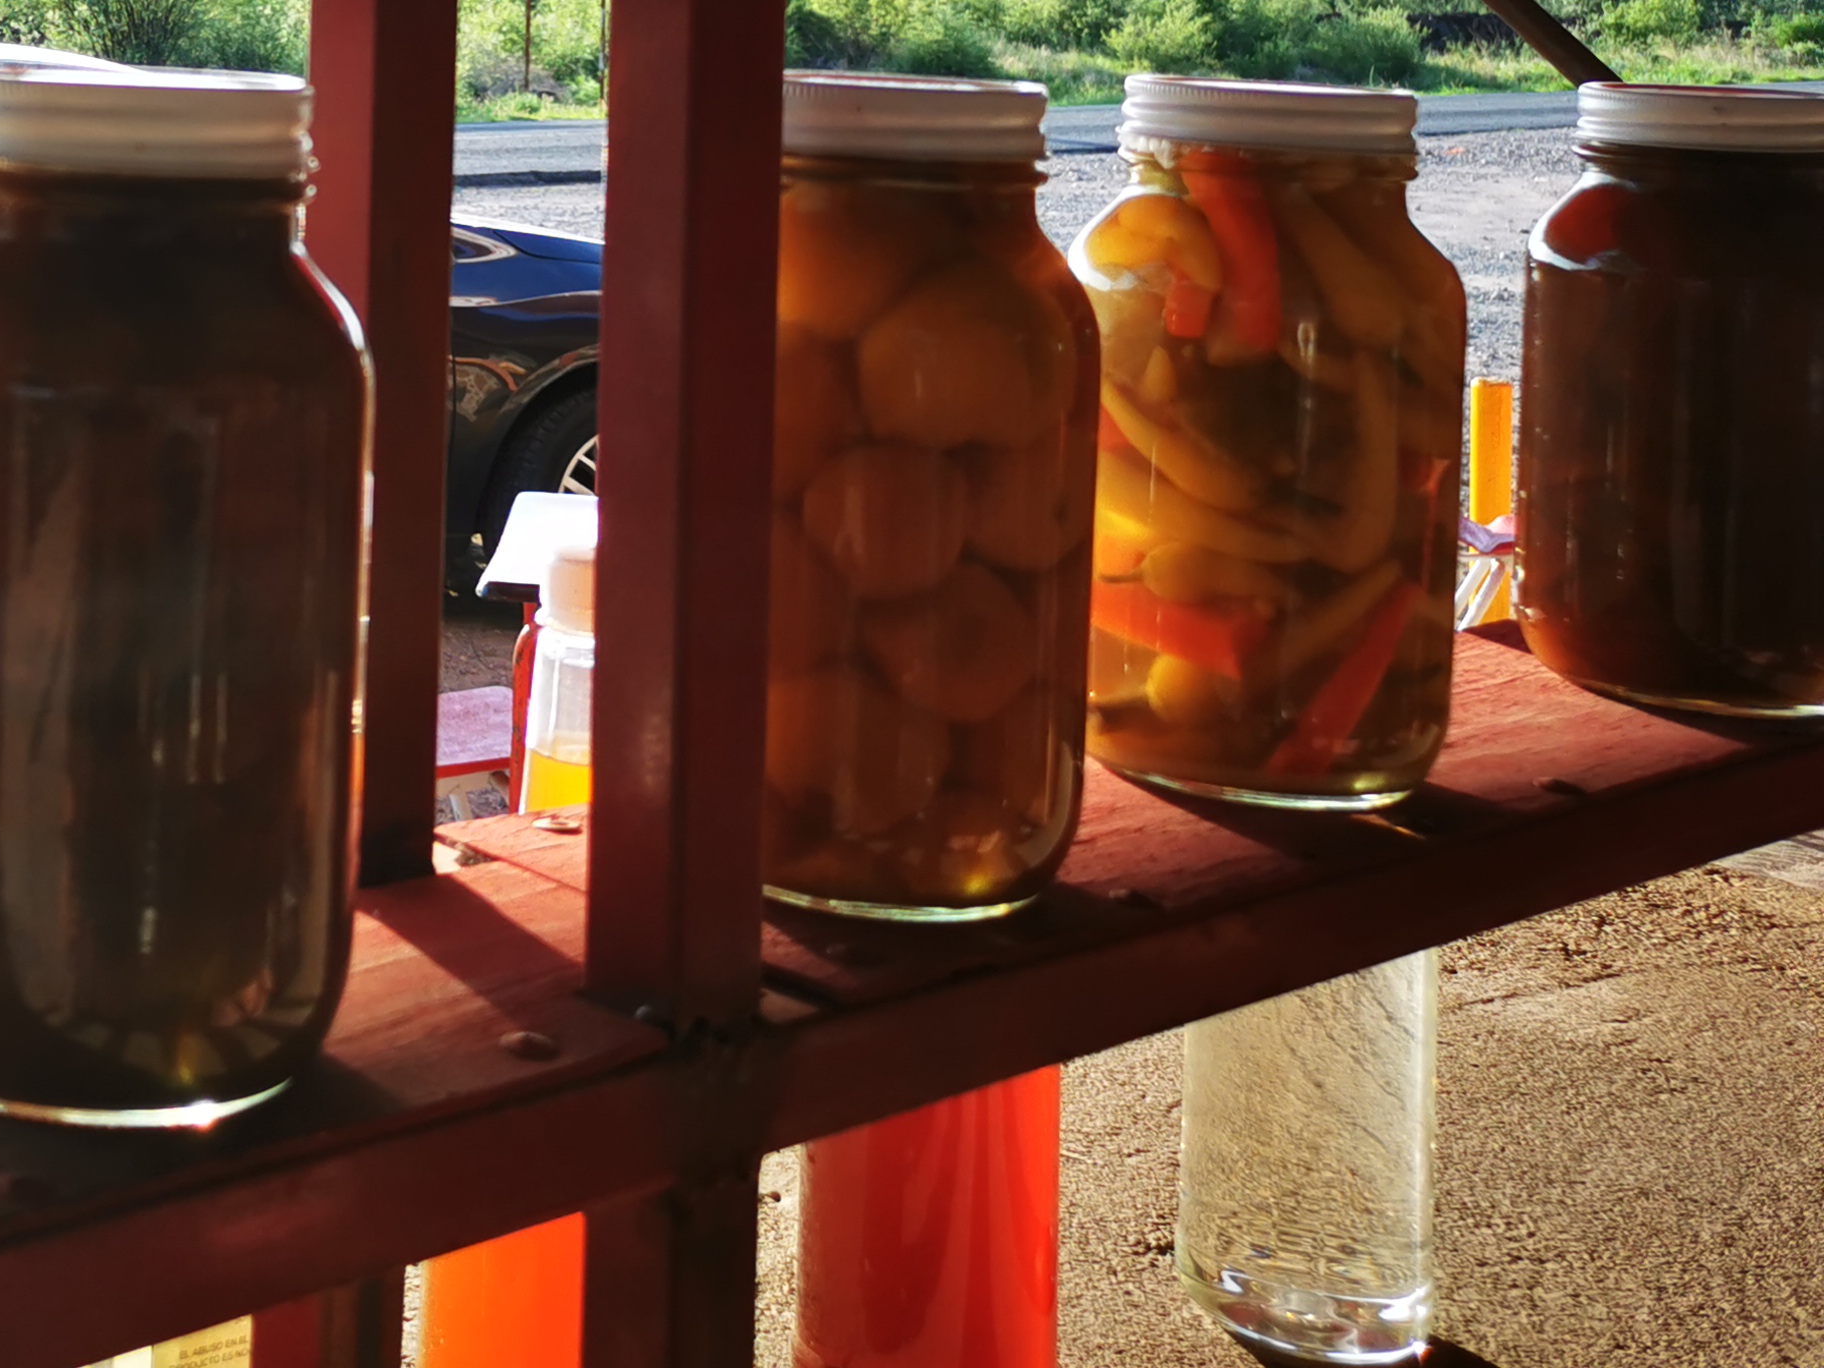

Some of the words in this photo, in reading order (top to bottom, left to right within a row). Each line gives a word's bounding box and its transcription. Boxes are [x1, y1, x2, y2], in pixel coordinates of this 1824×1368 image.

[179, 1350, 189, 1360] EL
[191, 1341, 223, 1357] ABUSO
[224, 1338, 237, 1348] EN
[238, 1335, 249, 1345] EL
